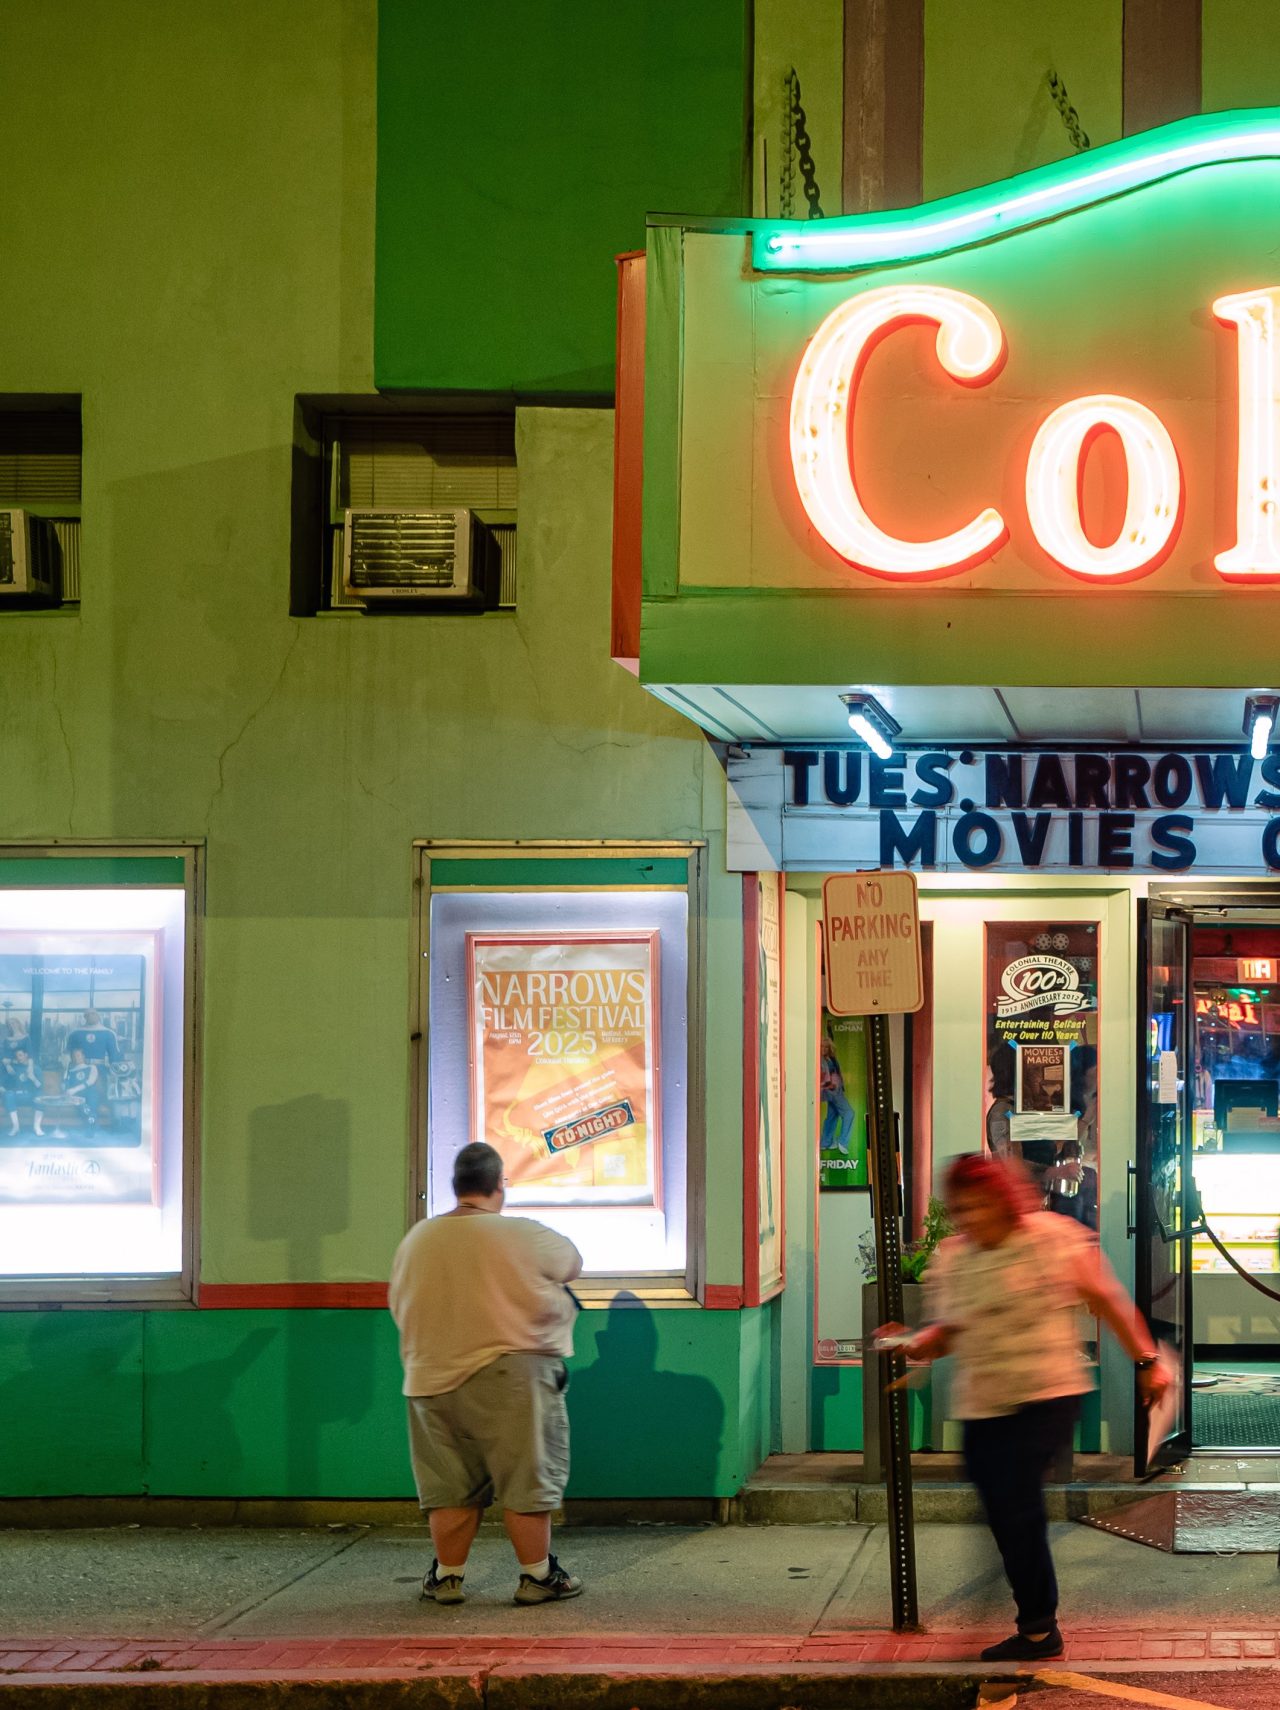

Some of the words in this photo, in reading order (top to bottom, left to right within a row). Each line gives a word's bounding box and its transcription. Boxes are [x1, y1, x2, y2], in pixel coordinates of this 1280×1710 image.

[880, 810, 1197, 869] MOVIES
[856, 882, 883, 908] NO
[831, 913, 912, 942] PARKING
[857, 948, 889, 967] ANY
[1005, 956, 1041, 976] COLONIAL
[1044, 956, 1075, 976] THEATRE
[23, 967, 61, 975] WELCOME
[62, 967, 72, 975] TO
[856, 970, 893, 989] TIME
[481, 972, 645, 1006] NARROWS
[1001, 1004, 1018, 1014] 1912
[1020, 992, 1062, 1011] ANNIVERSARY
[1062, 993, 1080, 1001] 2012
[482, 1007, 533, 1031] FILM
[538, 1006, 646, 1030] FESTIVAL
[995, 1019, 1050, 1029] Entertaining
[1053, 1019, 1087, 1029] Belfast
[527, 1031, 598, 1056] 2025
[1003, 1031, 1018, 1040] for
[1019, 1031, 1040, 1040] Over
[1041, 1031, 1054, 1040] 110
[1056, 1031, 1079, 1040] Years
[1026, 1056, 1061, 1065] MARGS
[820, 1159, 859, 1169] FRIDAY
